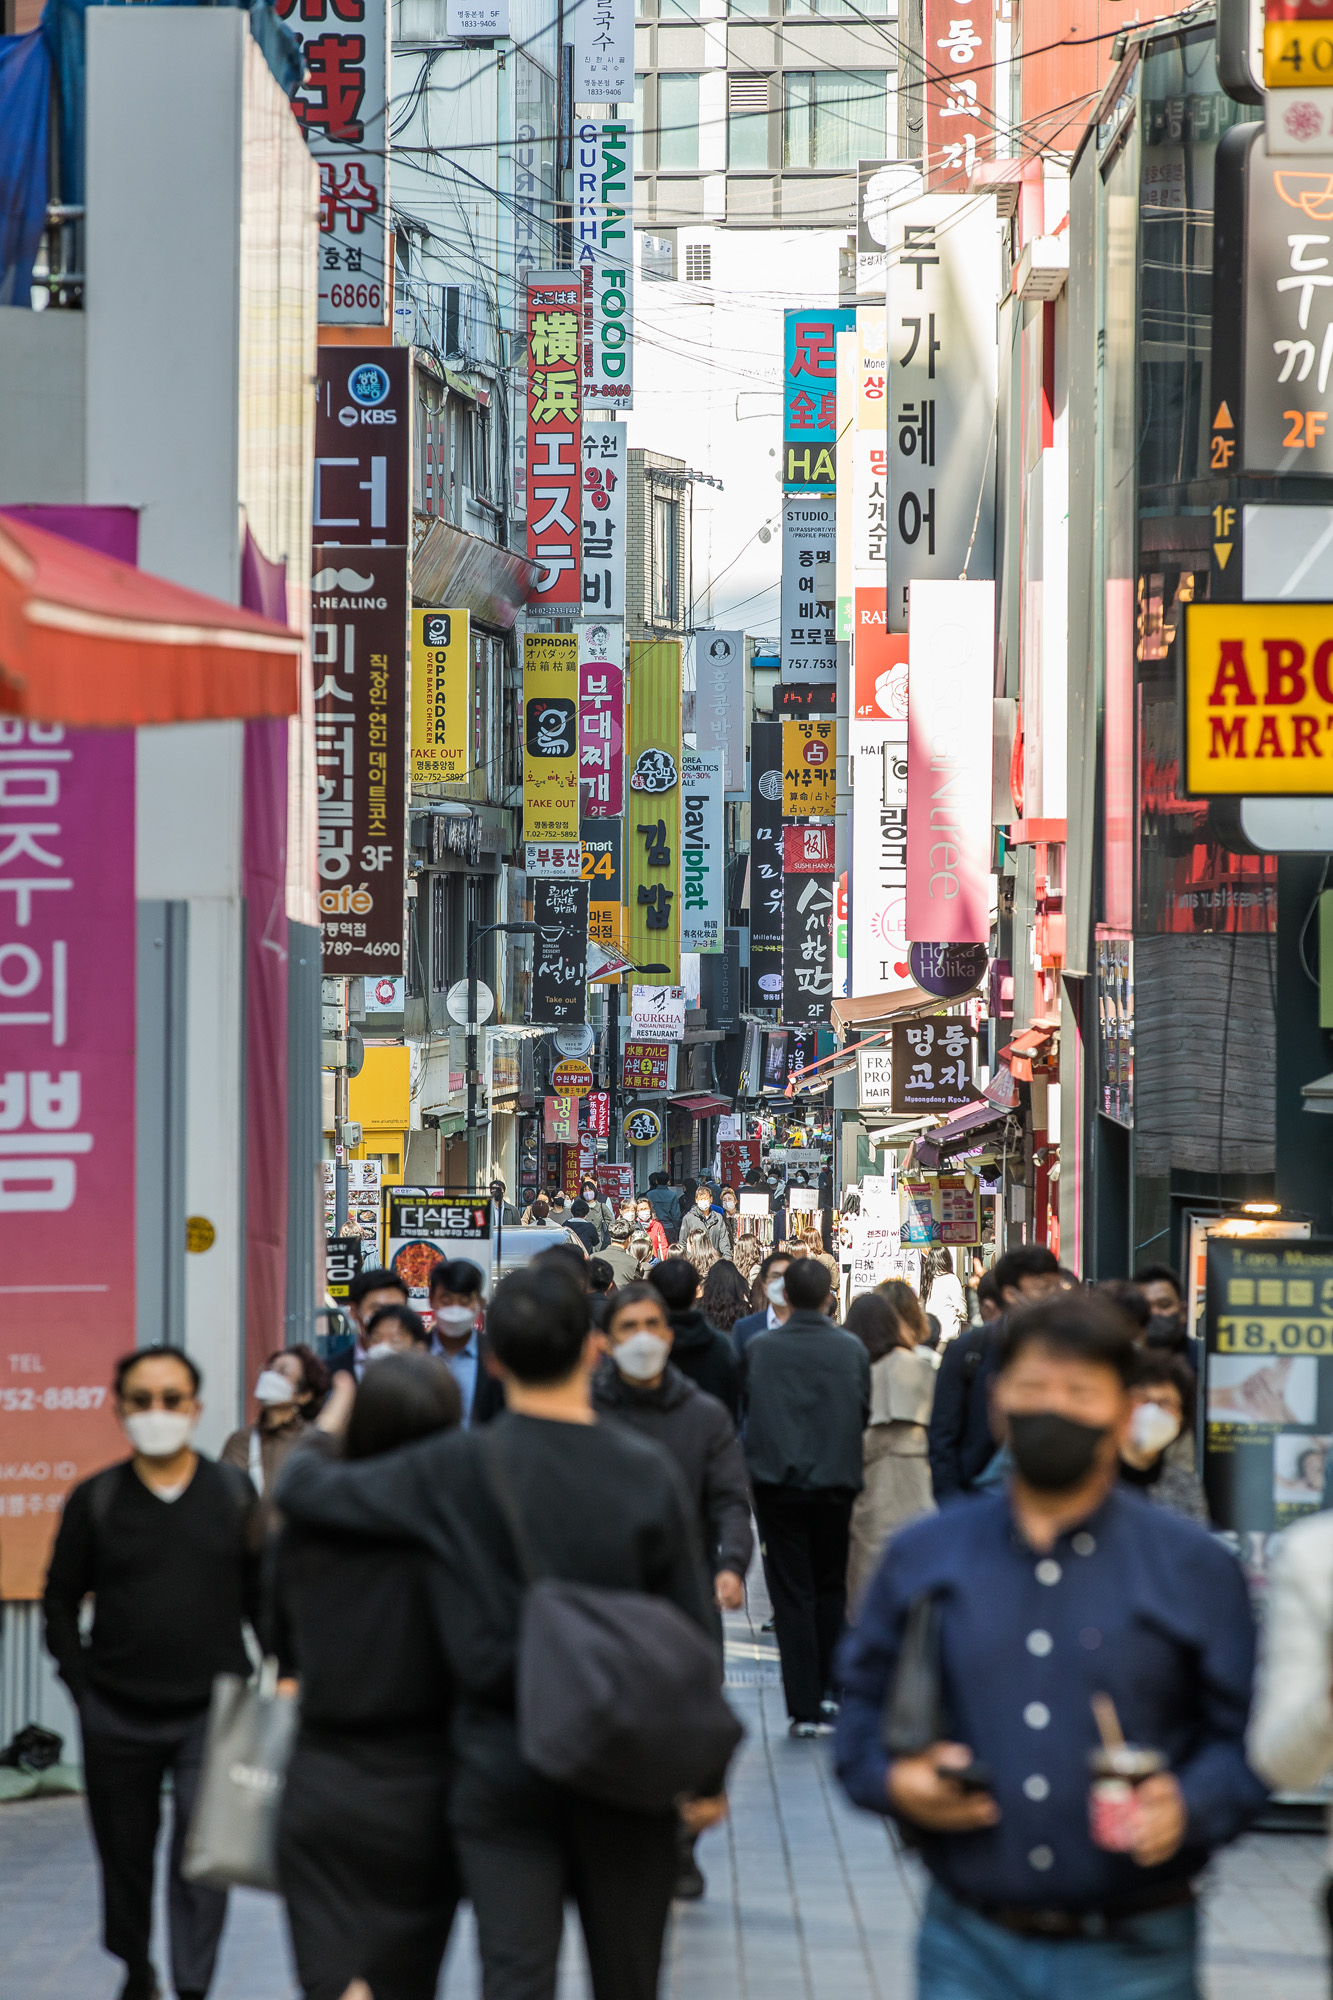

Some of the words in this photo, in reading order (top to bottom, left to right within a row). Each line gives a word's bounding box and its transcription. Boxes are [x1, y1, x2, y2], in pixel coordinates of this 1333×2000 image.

[457, 10, 486, 18] 명동본점
[460, 20, 496, 28] 1833-9406
[584, 78, 612, 88] 명동본점
[936, 0, 983, 178] 동교자
[578, 124, 598, 263] GURKHA
[600, 124, 626, 249] HALAL
[532, 290, 578, 306] よこはま
[600, 269, 626, 378] FOOD
[788, 322, 837, 379] 足
[584, 384, 630, 398] 75-8860
[897, 226, 942, 556] 두가헤어
[613, 398, 629, 406] 4F
[360, 408, 397, 425] KBS
[1282, 410, 1328, 448] 2F
[529, 311, 580, 594] 横浜エステ
[1210, 437, 1235, 469] 2F
[786, 512, 837, 522] STUDIO_
[1212, 505, 1236, 537] 1F
[320, 596, 388, 610] HEALING
[799, 602, 831, 620] 비자
[526, 638, 577, 648] OPPADAK
[526, 650, 576, 660] オパダック
[434, 650, 446, 745] OPPADAK
[858, 705, 873, 715] 4F
[580, 675, 614, 802] 부대찌개
[798, 723, 832, 739] 명동
[440, 749, 464, 758] OUT
[807, 743, 824, 762] 占
[416, 761, 455, 770] 명동중앙점
[368, 752, 388, 837] 데이트코스
[527, 800, 552, 808] TAKE
[555, 800, 576, 808] OUT
[591, 806, 606, 816] 2F
[534, 821, 570, 830] 명동중앙점
[581, 840, 613, 852] emart
[684, 794, 710, 911] baviphat
[360, 846, 392, 872] 3F
[536, 848, 580, 868] 부동산
[578, 852, 616, 880] 24
[636, 819, 674, 929] 김밥
[318, 882, 374, 915] afé
[589, 910, 614, 924] 마트
[704, 920, 718, 929] 韩国
[538, 956, 584, 986] 설빙
[920, 960, 976, 978] Holika
[671, 990, 683, 999] 5F
[554, 1006, 568, 1016] 2F
[634, 1013, 682, 1024] GURKHA
[808, 1004, 825, 1017] 2F
[636, 1030, 678, 1038] RESTAURANT
[906, 1024, 970, 1058] 명동
[555, 1074, 590, 1084] 수원왕갈비
[904, 1060, 970, 1091] 교자
[866, 1088, 890, 1098] HAIR
[552, 1097, 572, 1141] 냉면
[400, 1206, 473, 1228] 더식당
[866, 1230, 889, 1238] 렌즈미
[1226, 1322, 1333, 1353] 18,00
